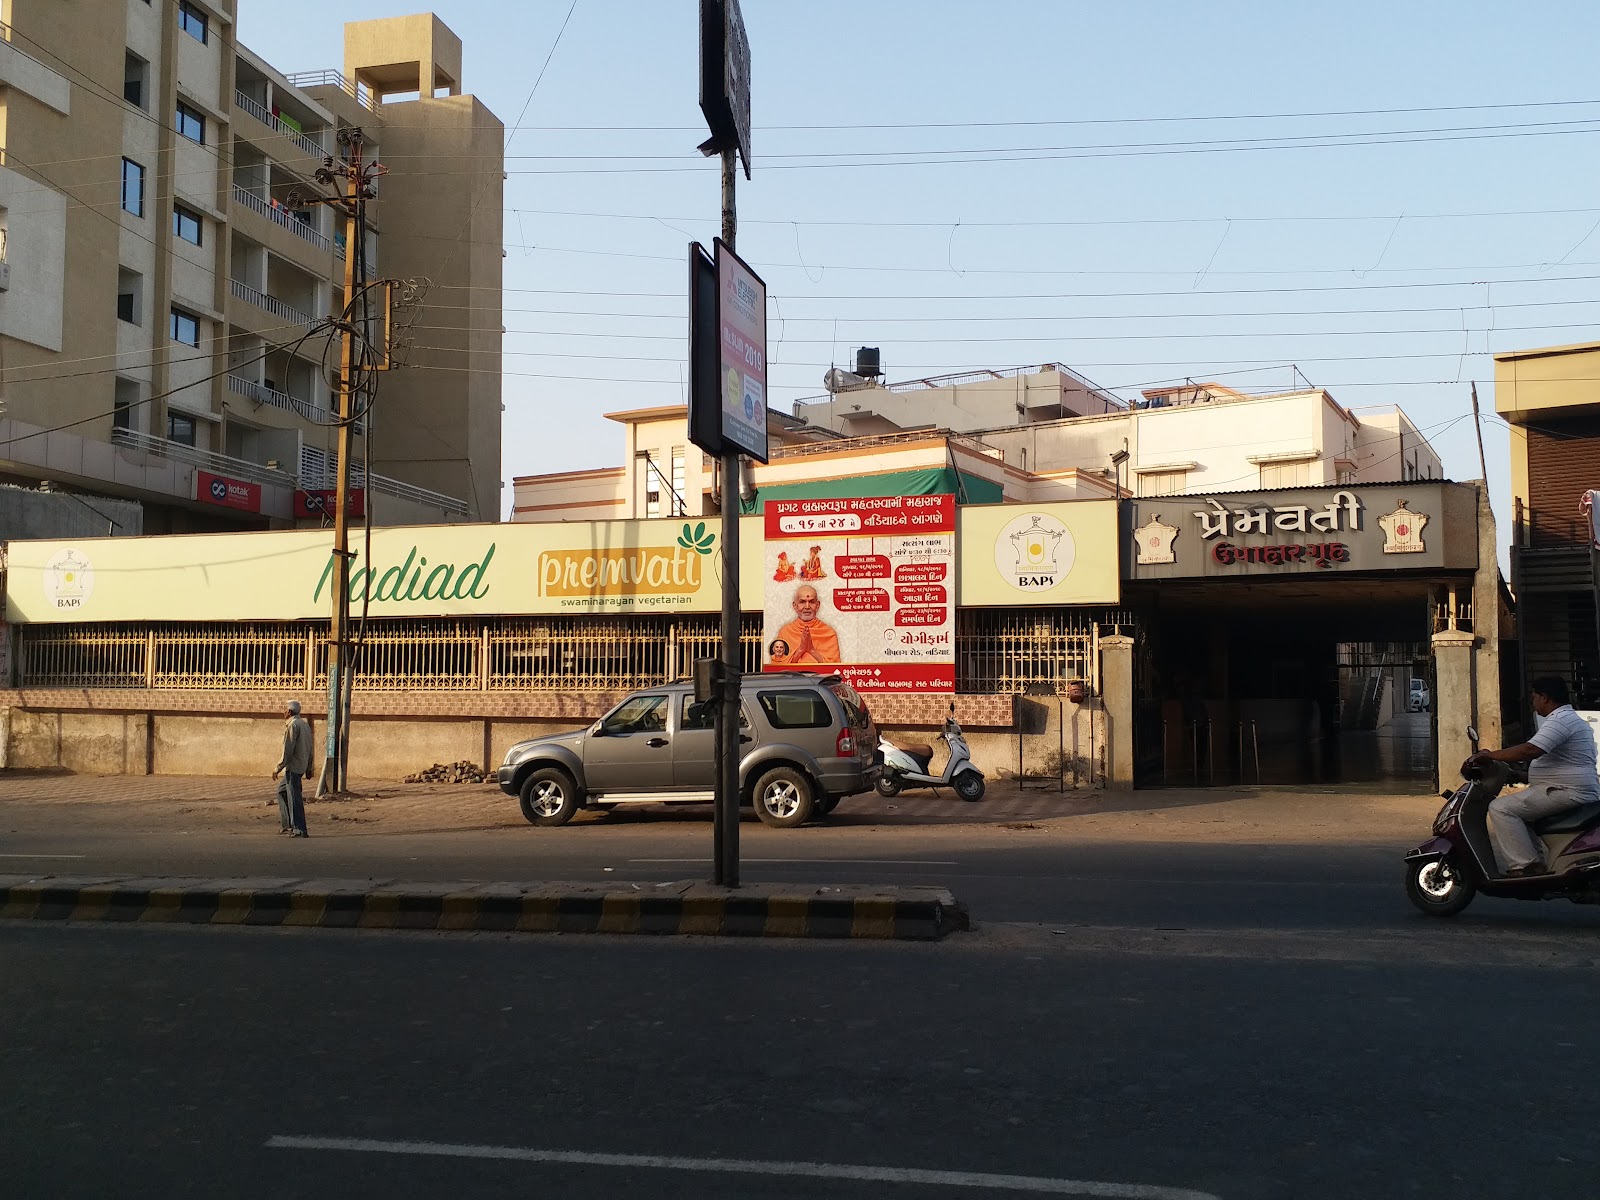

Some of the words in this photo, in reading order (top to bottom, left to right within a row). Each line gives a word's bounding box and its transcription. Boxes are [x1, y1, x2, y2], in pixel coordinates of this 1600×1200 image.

[744, 342, 762, 372] 2019
[228, 484, 248, 496] kotak
[328, 494, 354, 503] kok
[777, 502, 798, 514] પ્રગટ
[851, 496, 902, 511] મહંતસ્વામી
[906, 496, 942, 508] મહારાજ
[818, 520, 826, 530] થી
[829, 518, 846, 528] ૨૪
[864, 511, 908, 527] નડિયાદને
[911, 509, 942, 525] આંગણે
[1193, 490, 1360, 540] प्रेमवती
[540, 546, 700, 598] premvati
[928, 572, 942, 581] દિન
[1019, 576, 1054, 586] BAPS
[561, 598, 634, 607] swaminarayan
[638, 596, 692, 605] vegetarian
[924, 592, 938, 602] દિન
[58, 598, 80, 608] BAPS
[927, 614, 940, 623] દિન
[900, 630, 950, 646] યોગીફાર્મ
[926, 648, 950, 656] નડિયાદ
[930, 678, 952, 688] પરિવાર
